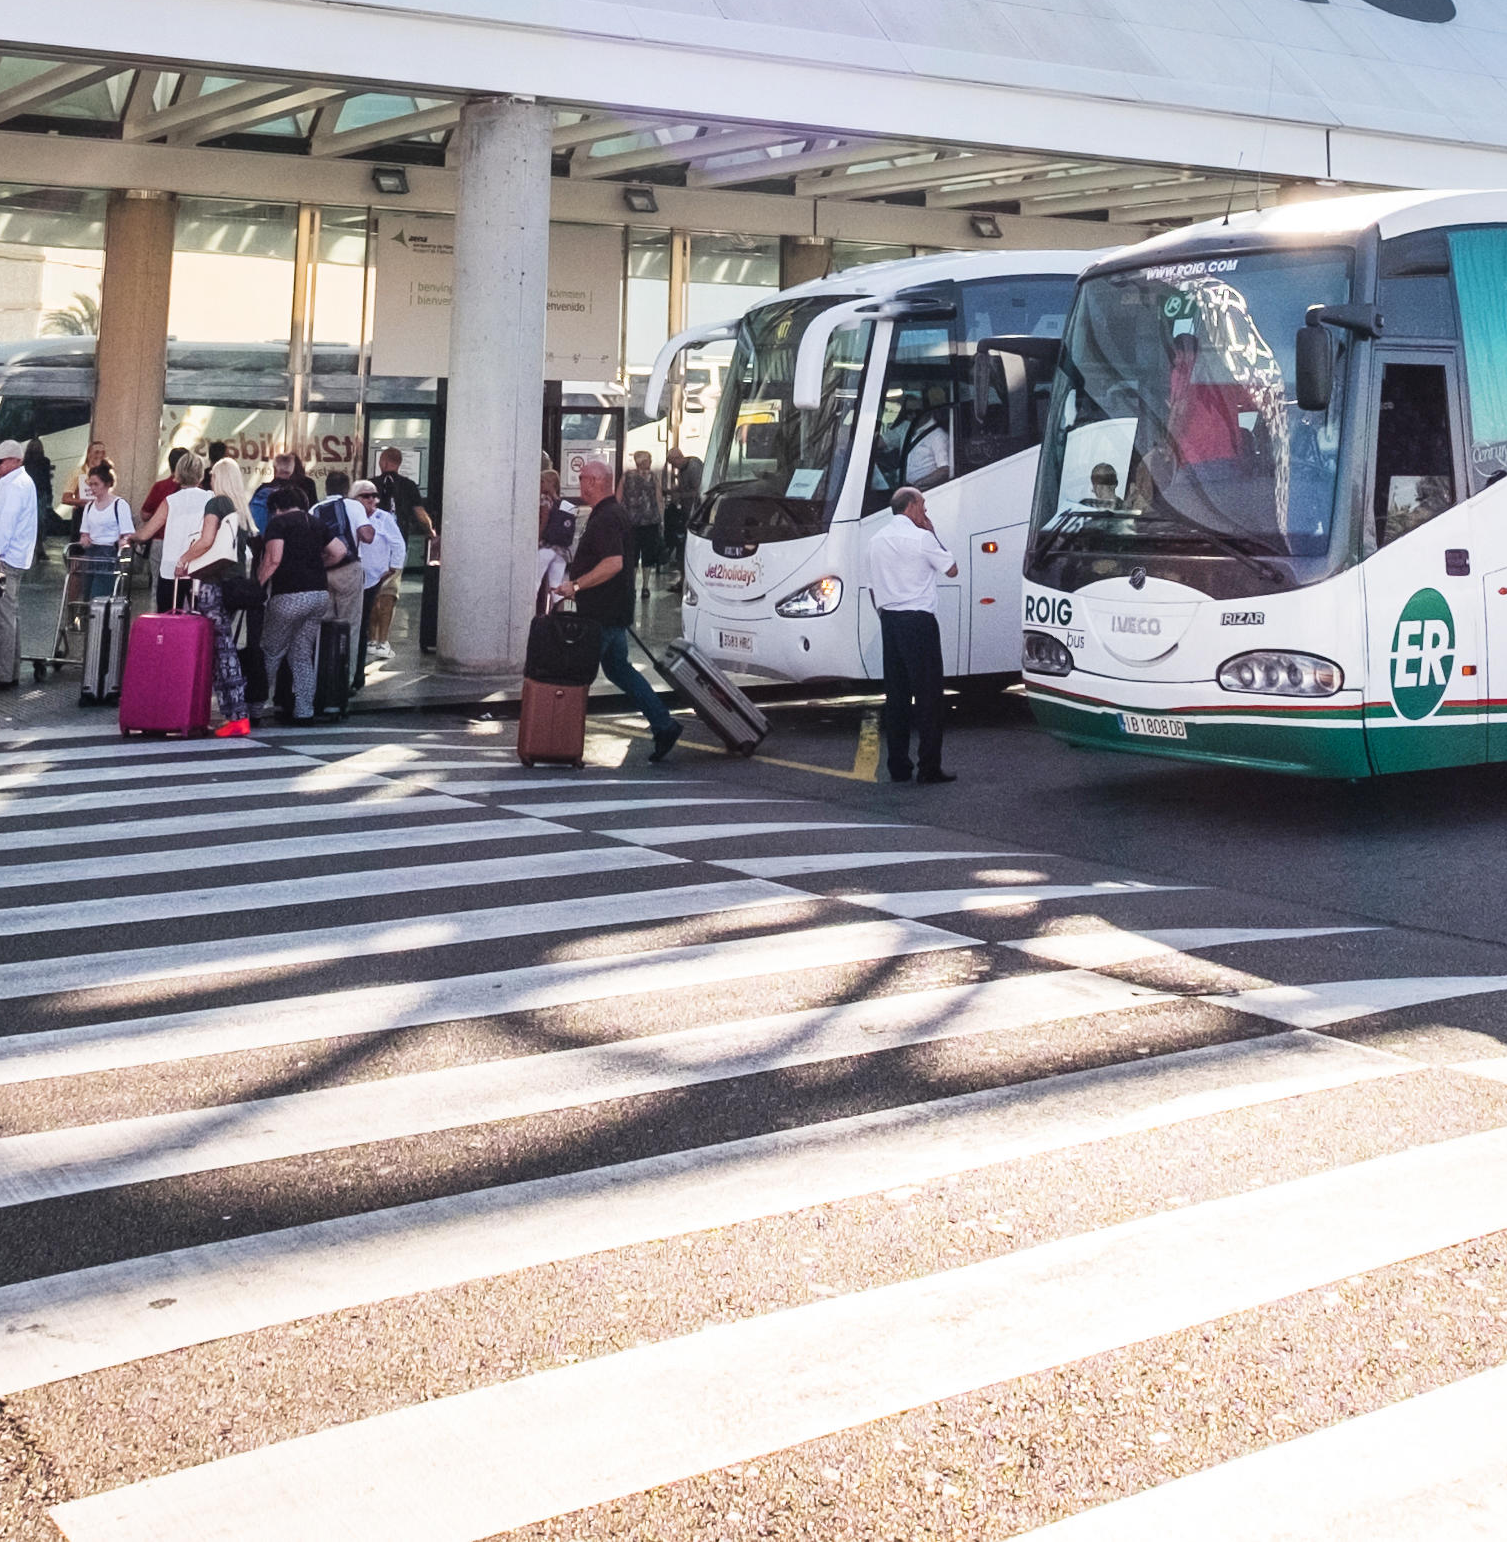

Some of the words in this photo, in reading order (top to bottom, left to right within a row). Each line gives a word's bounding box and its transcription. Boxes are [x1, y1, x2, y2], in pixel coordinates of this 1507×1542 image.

[1146, 259, 1239, 280] WWW.ROIG.COM
[546, 302, 586, 313] envenido
[705, 563, 756, 586] Jet2holidays
[1025, 595, 1073, 626] ROIG
[1220, 611, 1265, 626] IRIZAR
[1111, 615, 1162, 636] IVECO
[1066, 631, 1085, 649] bus
[1393, 619, 1450, 689] ER
[1141, 718, 1170, 735] 1808
